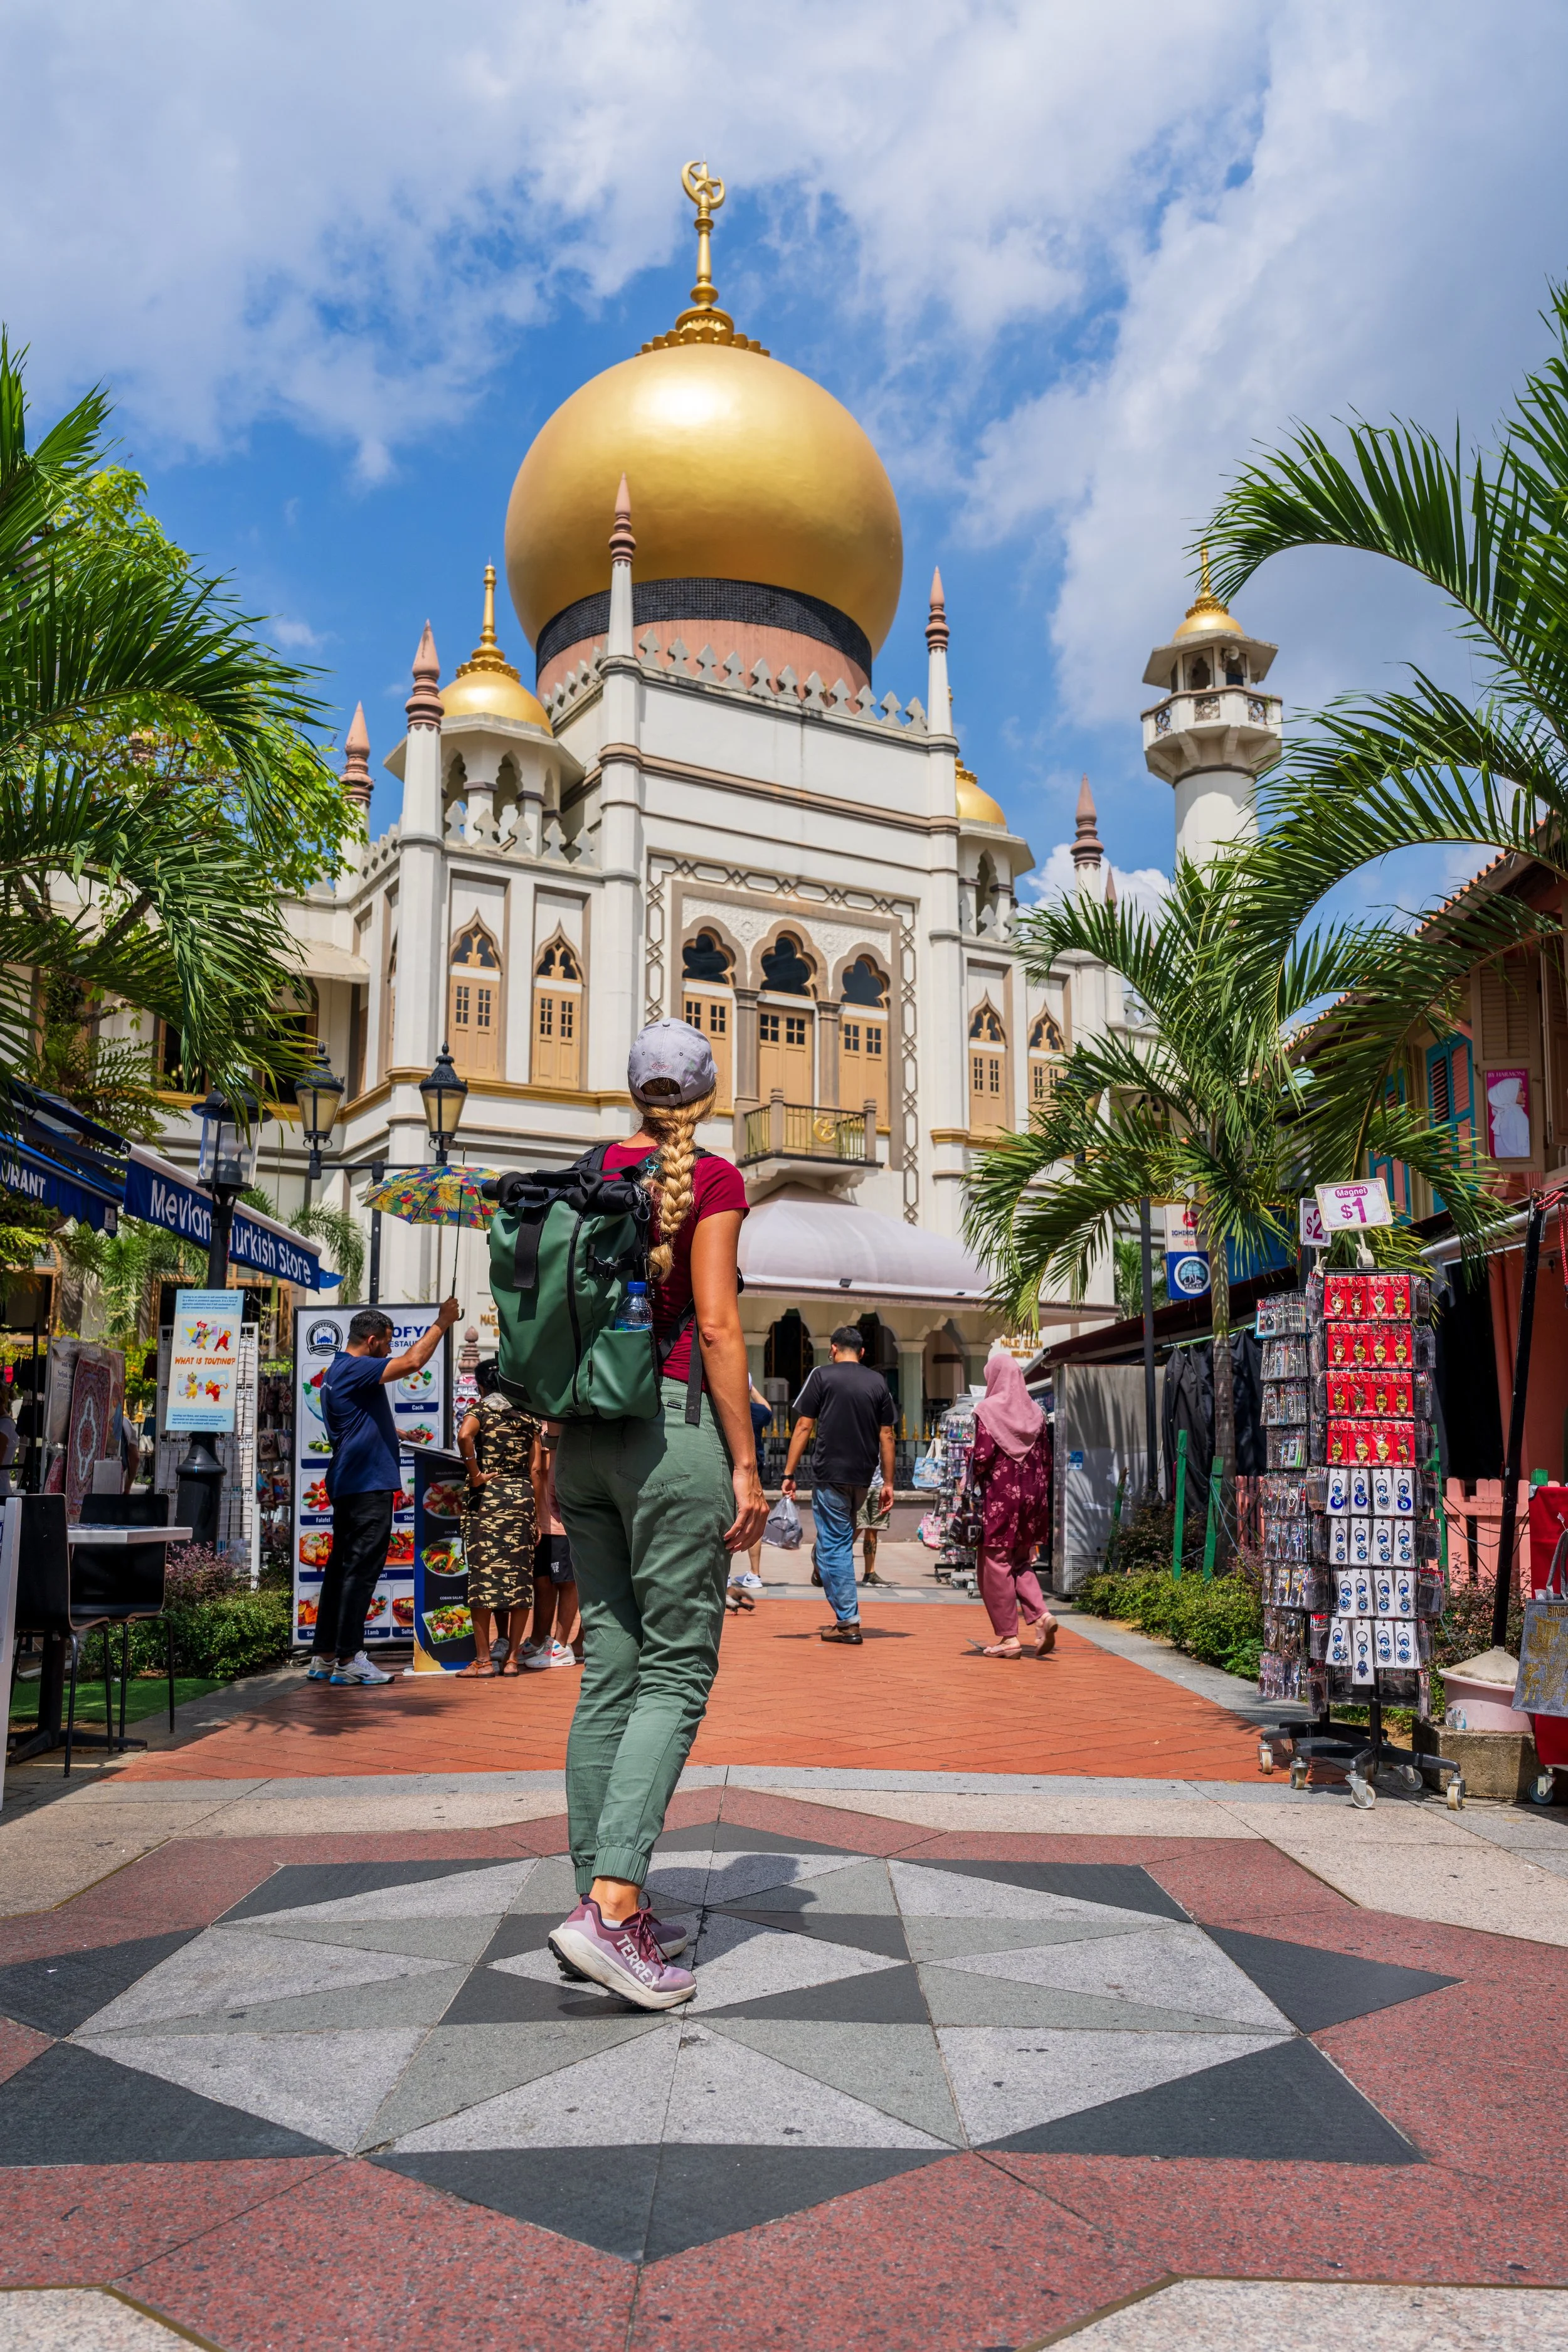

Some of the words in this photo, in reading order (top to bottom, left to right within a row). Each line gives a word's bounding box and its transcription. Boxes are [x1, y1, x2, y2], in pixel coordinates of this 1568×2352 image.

[1337, 1187, 1367, 1197] Magnet
[1306, 1208, 1323, 1239] $2
[1340, 1197, 1367, 1223] $1
[151, 1179, 211, 1241] Mevlan
[229, 1221, 276, 1269] Turkish
[278, 1242, 312, 1285] Store
[175, 1357, 194, 1365] WHAT
[616, 1933, 660, 1991] TERREX
